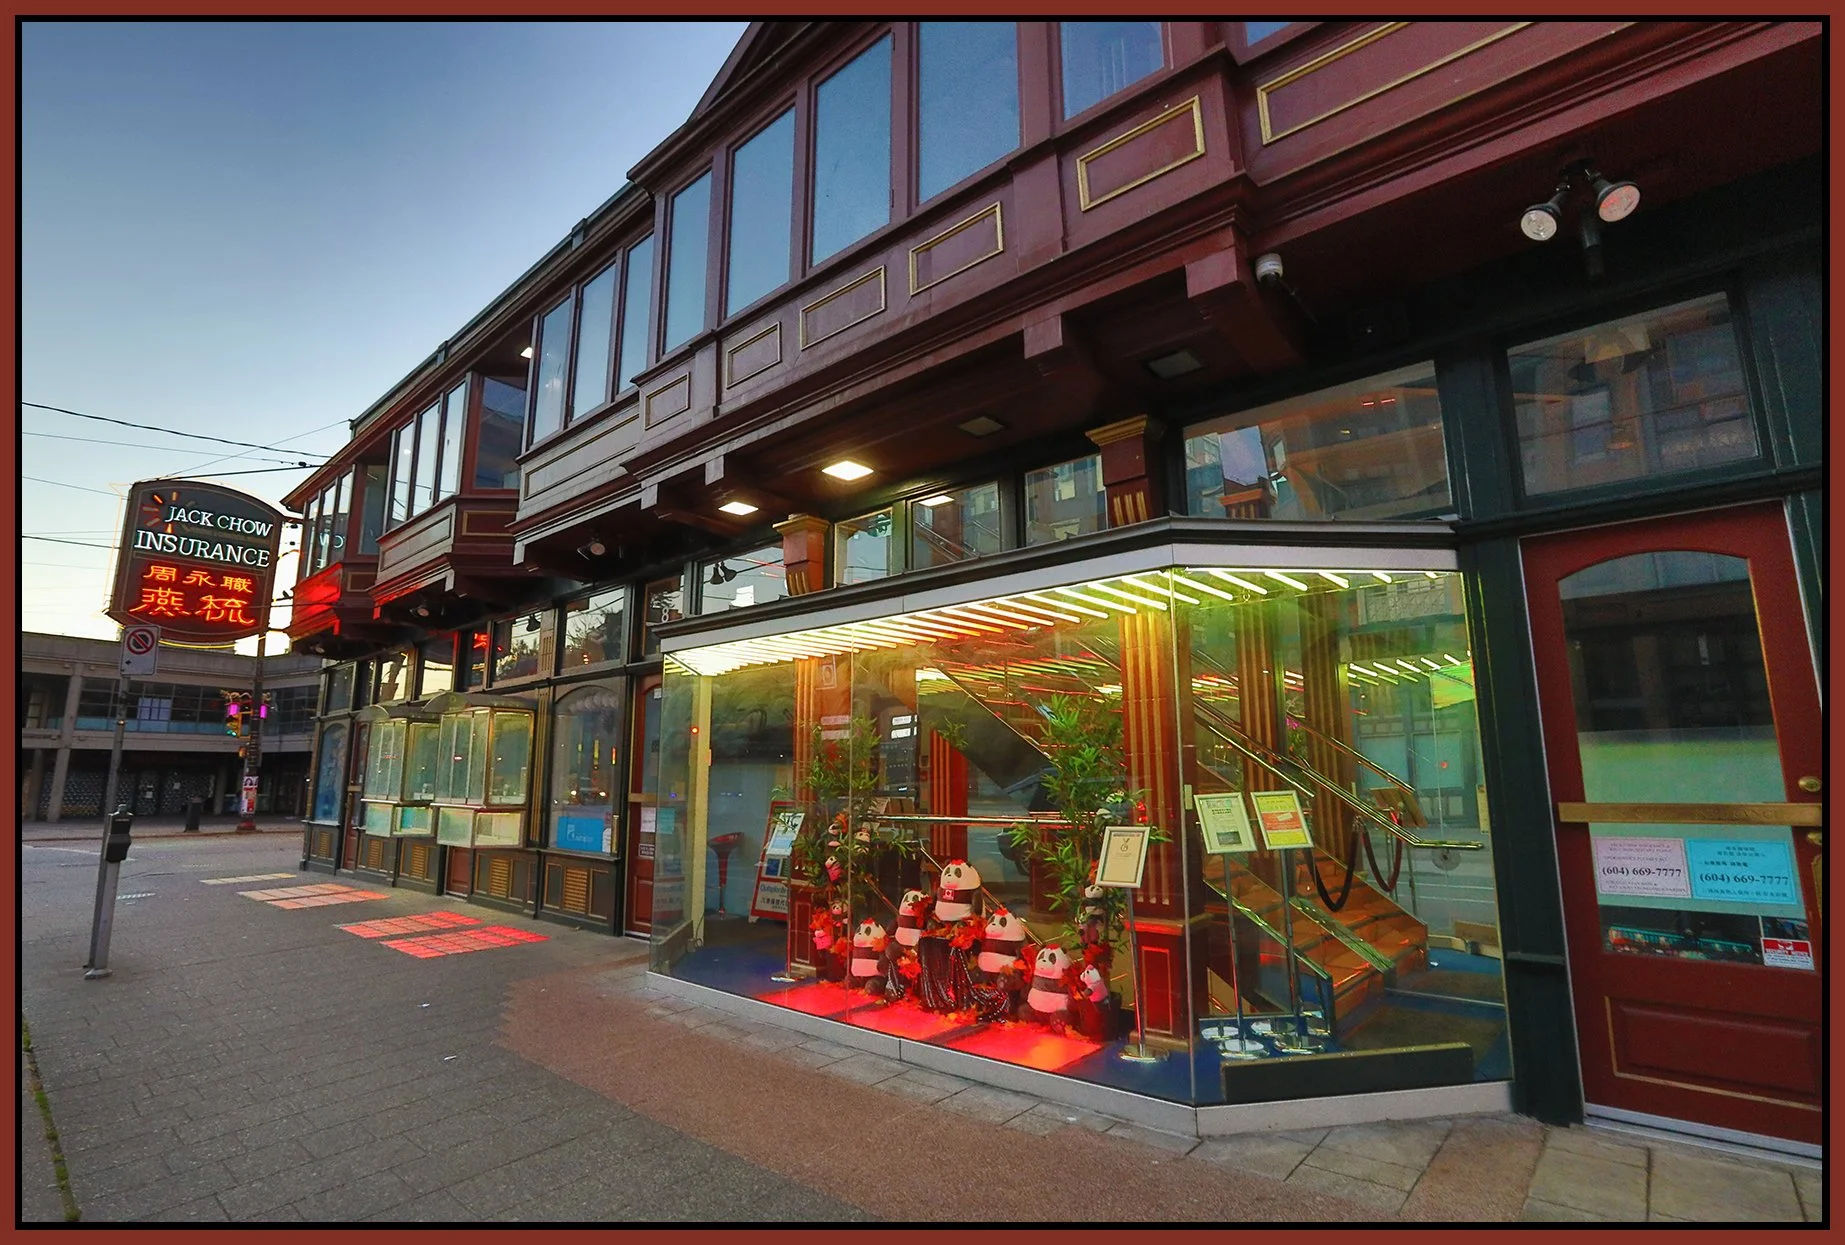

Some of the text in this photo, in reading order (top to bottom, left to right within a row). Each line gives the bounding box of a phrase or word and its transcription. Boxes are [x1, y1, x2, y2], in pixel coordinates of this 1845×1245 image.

[165, 506, 273, 537] JACK CHOW
[134, 530, 270, 567] INSURANCE
[1602, 866, 1682, 877] (604) 669-7777
[1699, 873, 1789, 885] (604) 669-7777
